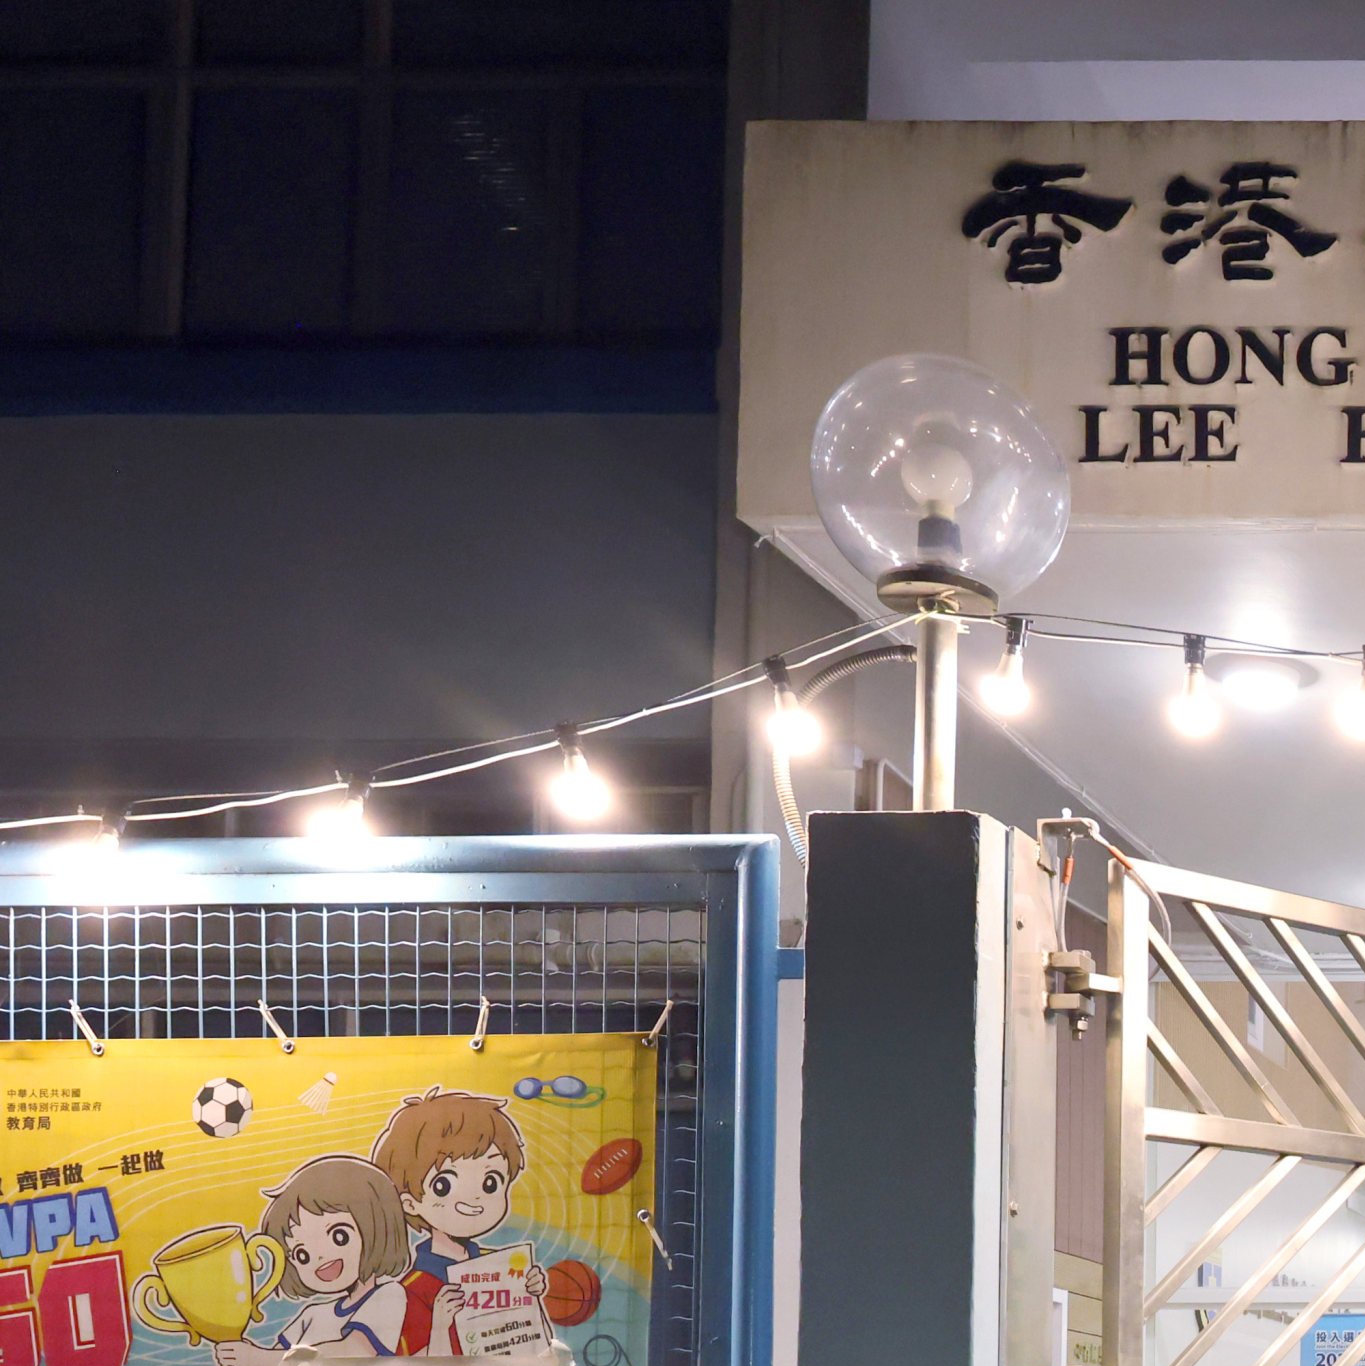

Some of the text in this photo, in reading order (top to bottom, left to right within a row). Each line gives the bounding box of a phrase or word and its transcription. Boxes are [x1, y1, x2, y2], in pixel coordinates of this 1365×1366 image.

[1109, 325, 1353, 388] HONG
[1079, 404, 1237, 463] LEE
[7, 1088, 81, 1098] 中華人民共和國
[7, 1102, 102, 1112] 香港特別行政區政府
[6, 1116, 51, 1130] 教育局
[17, 1150, 165, 1192] 齊齊做 一起做
